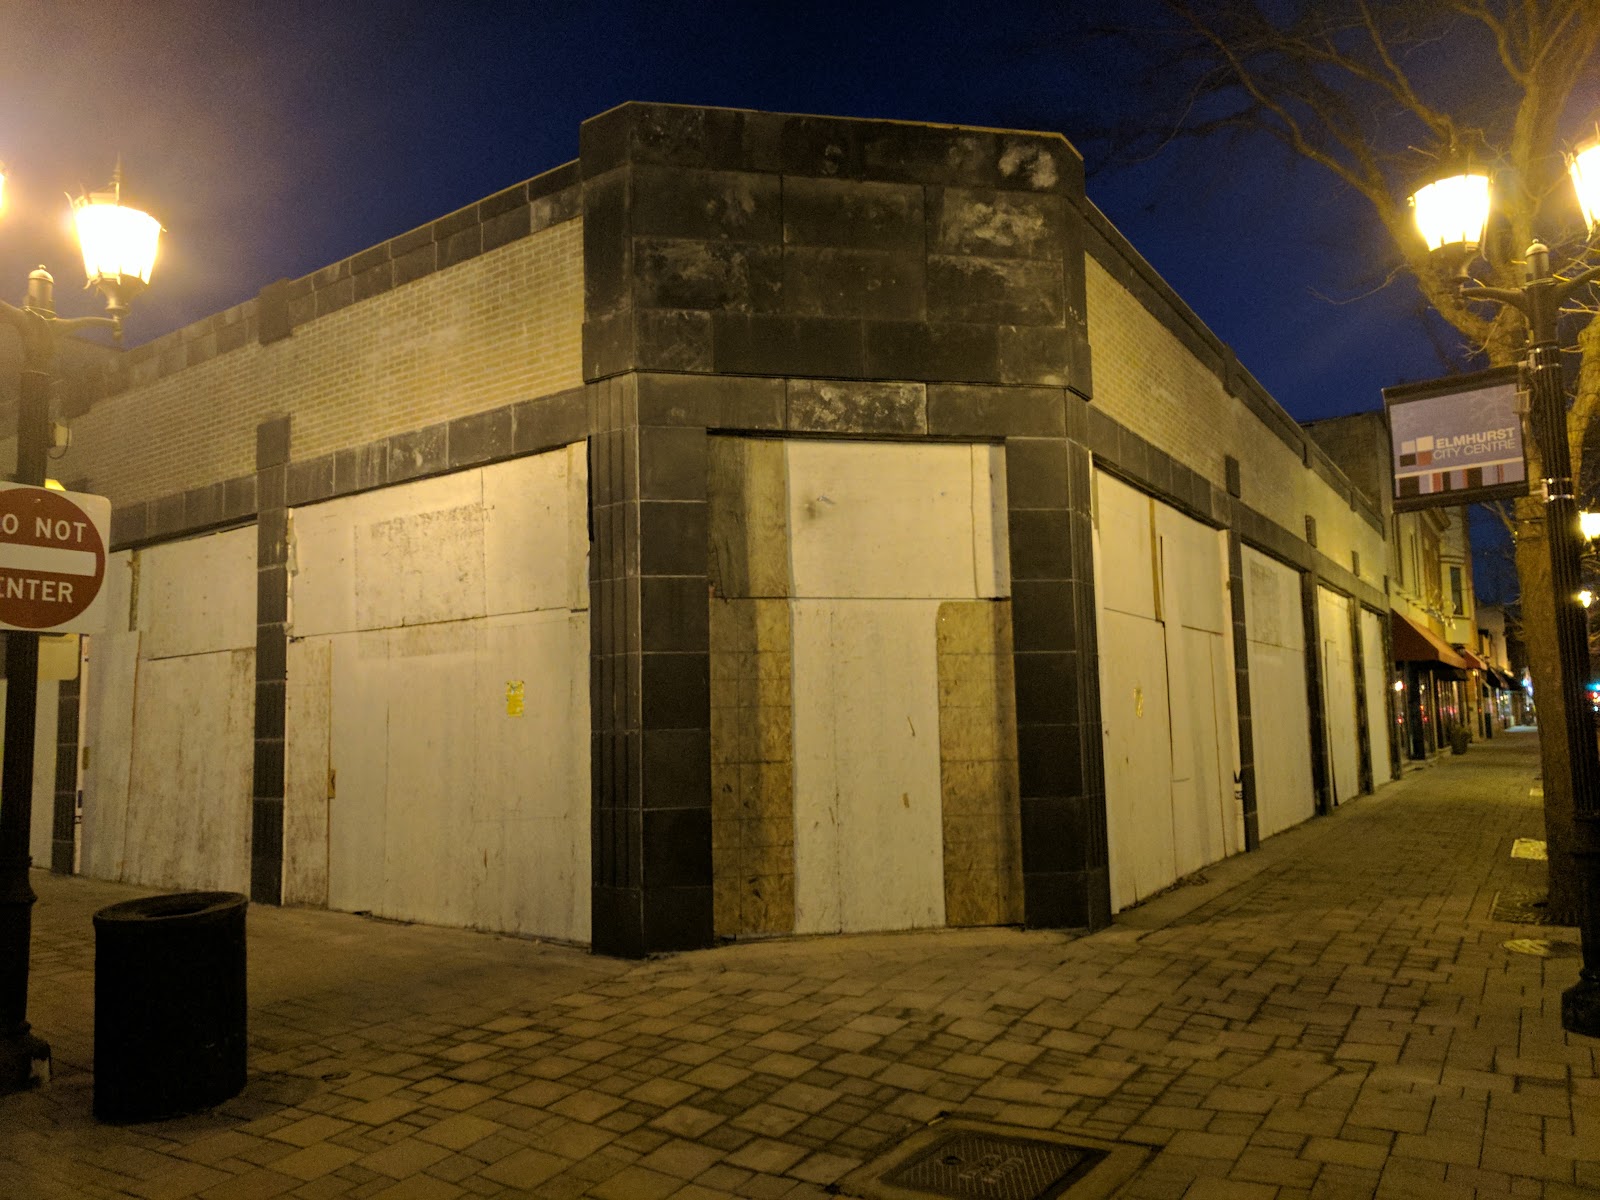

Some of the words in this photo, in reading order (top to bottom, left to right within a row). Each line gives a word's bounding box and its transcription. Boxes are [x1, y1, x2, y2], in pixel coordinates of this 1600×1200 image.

[1433, 446, 1460, 460] CITY
[1463, 439, 1516, 455] CENTRE
[1436, 427, 1516, 449] ELMHURST
[0, 513, 19, 534] O
[35, 517, 87, 543] NOT
[0, 575, 74, 603] NTER
